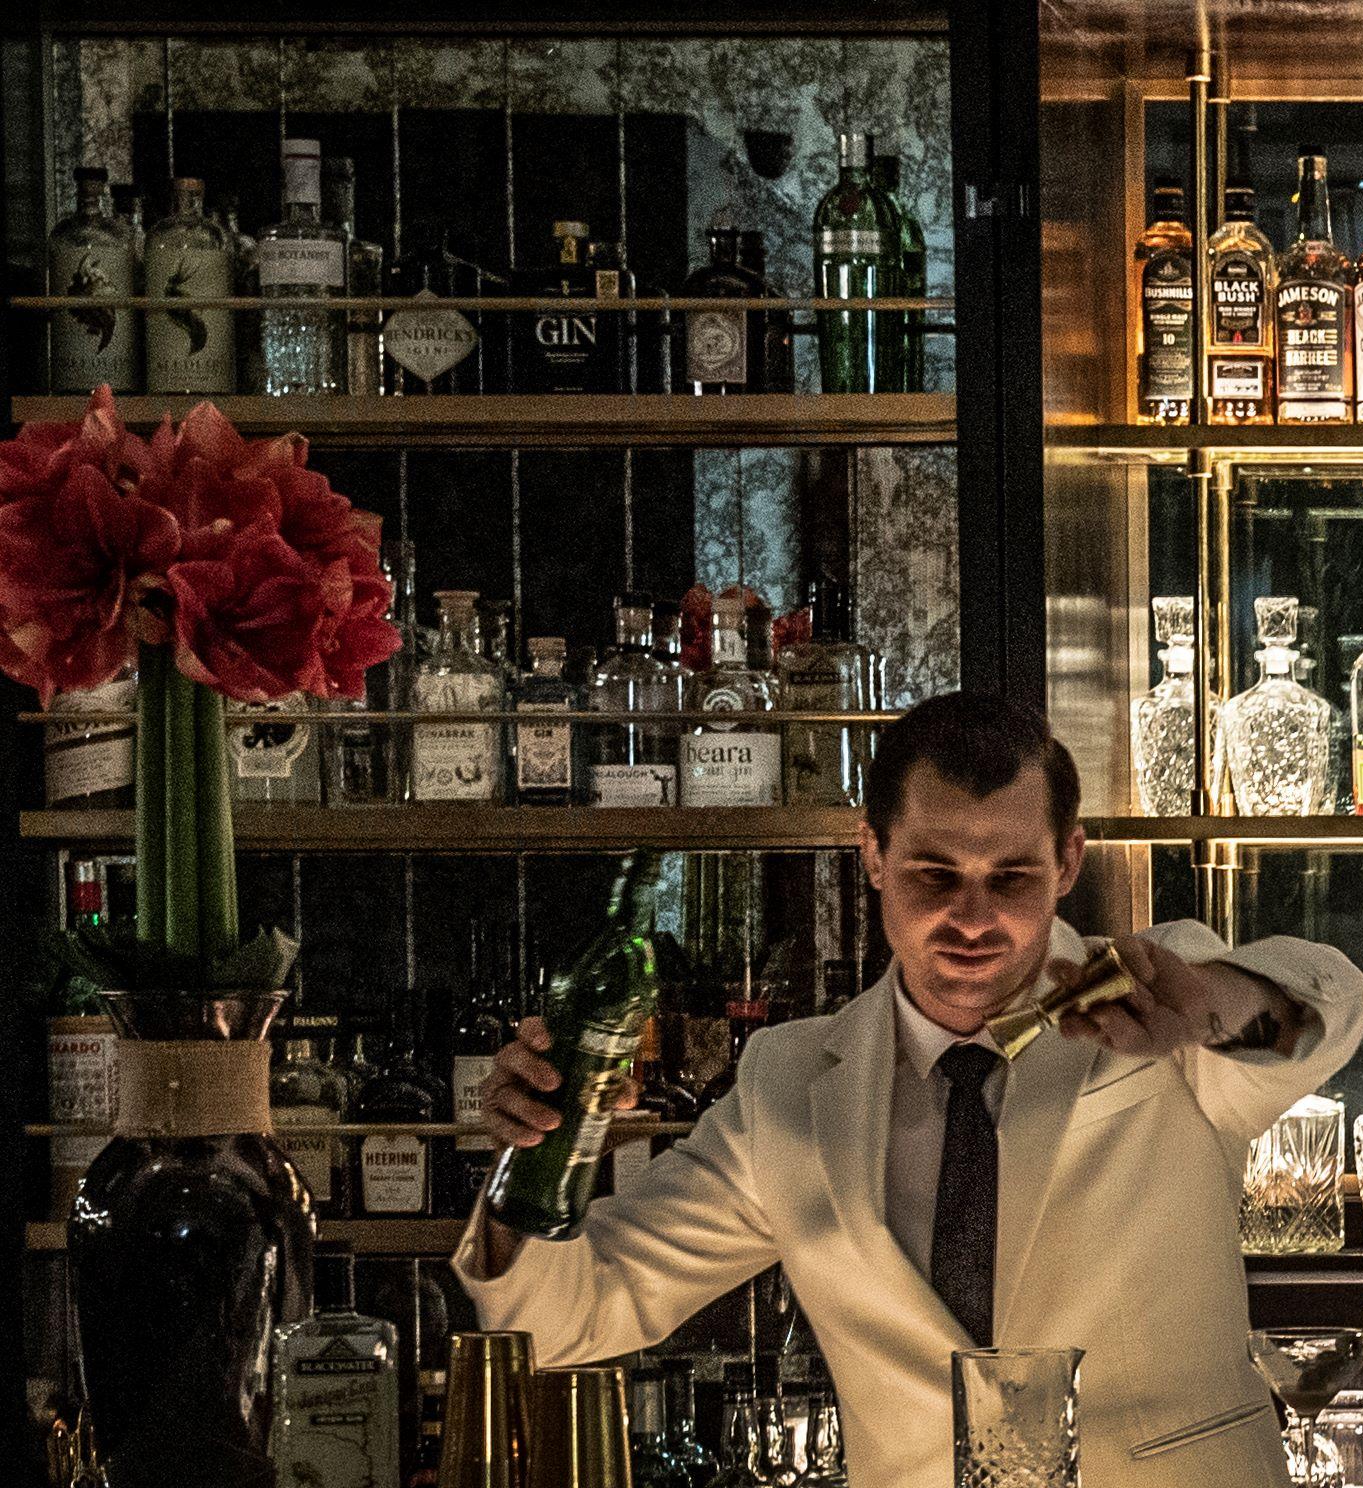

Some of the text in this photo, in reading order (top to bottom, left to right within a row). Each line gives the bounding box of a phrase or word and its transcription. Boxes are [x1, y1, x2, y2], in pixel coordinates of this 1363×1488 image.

[1145, 286, 1193, 300] BUSHMILLS
[1213, 280, 1260, 292] BLACK
[1217, 292, 1257, 303] BUSH
[1277, 286, 1340, 308] JAMESON
[535, 317, 598, 346] GIN
[1286, 329, 1328, 345] BLACK
[1162, 333, 1176, 345] 10
[687, 741, 753, 764] beara
[364, 1153, 418, 1166] HEERING
